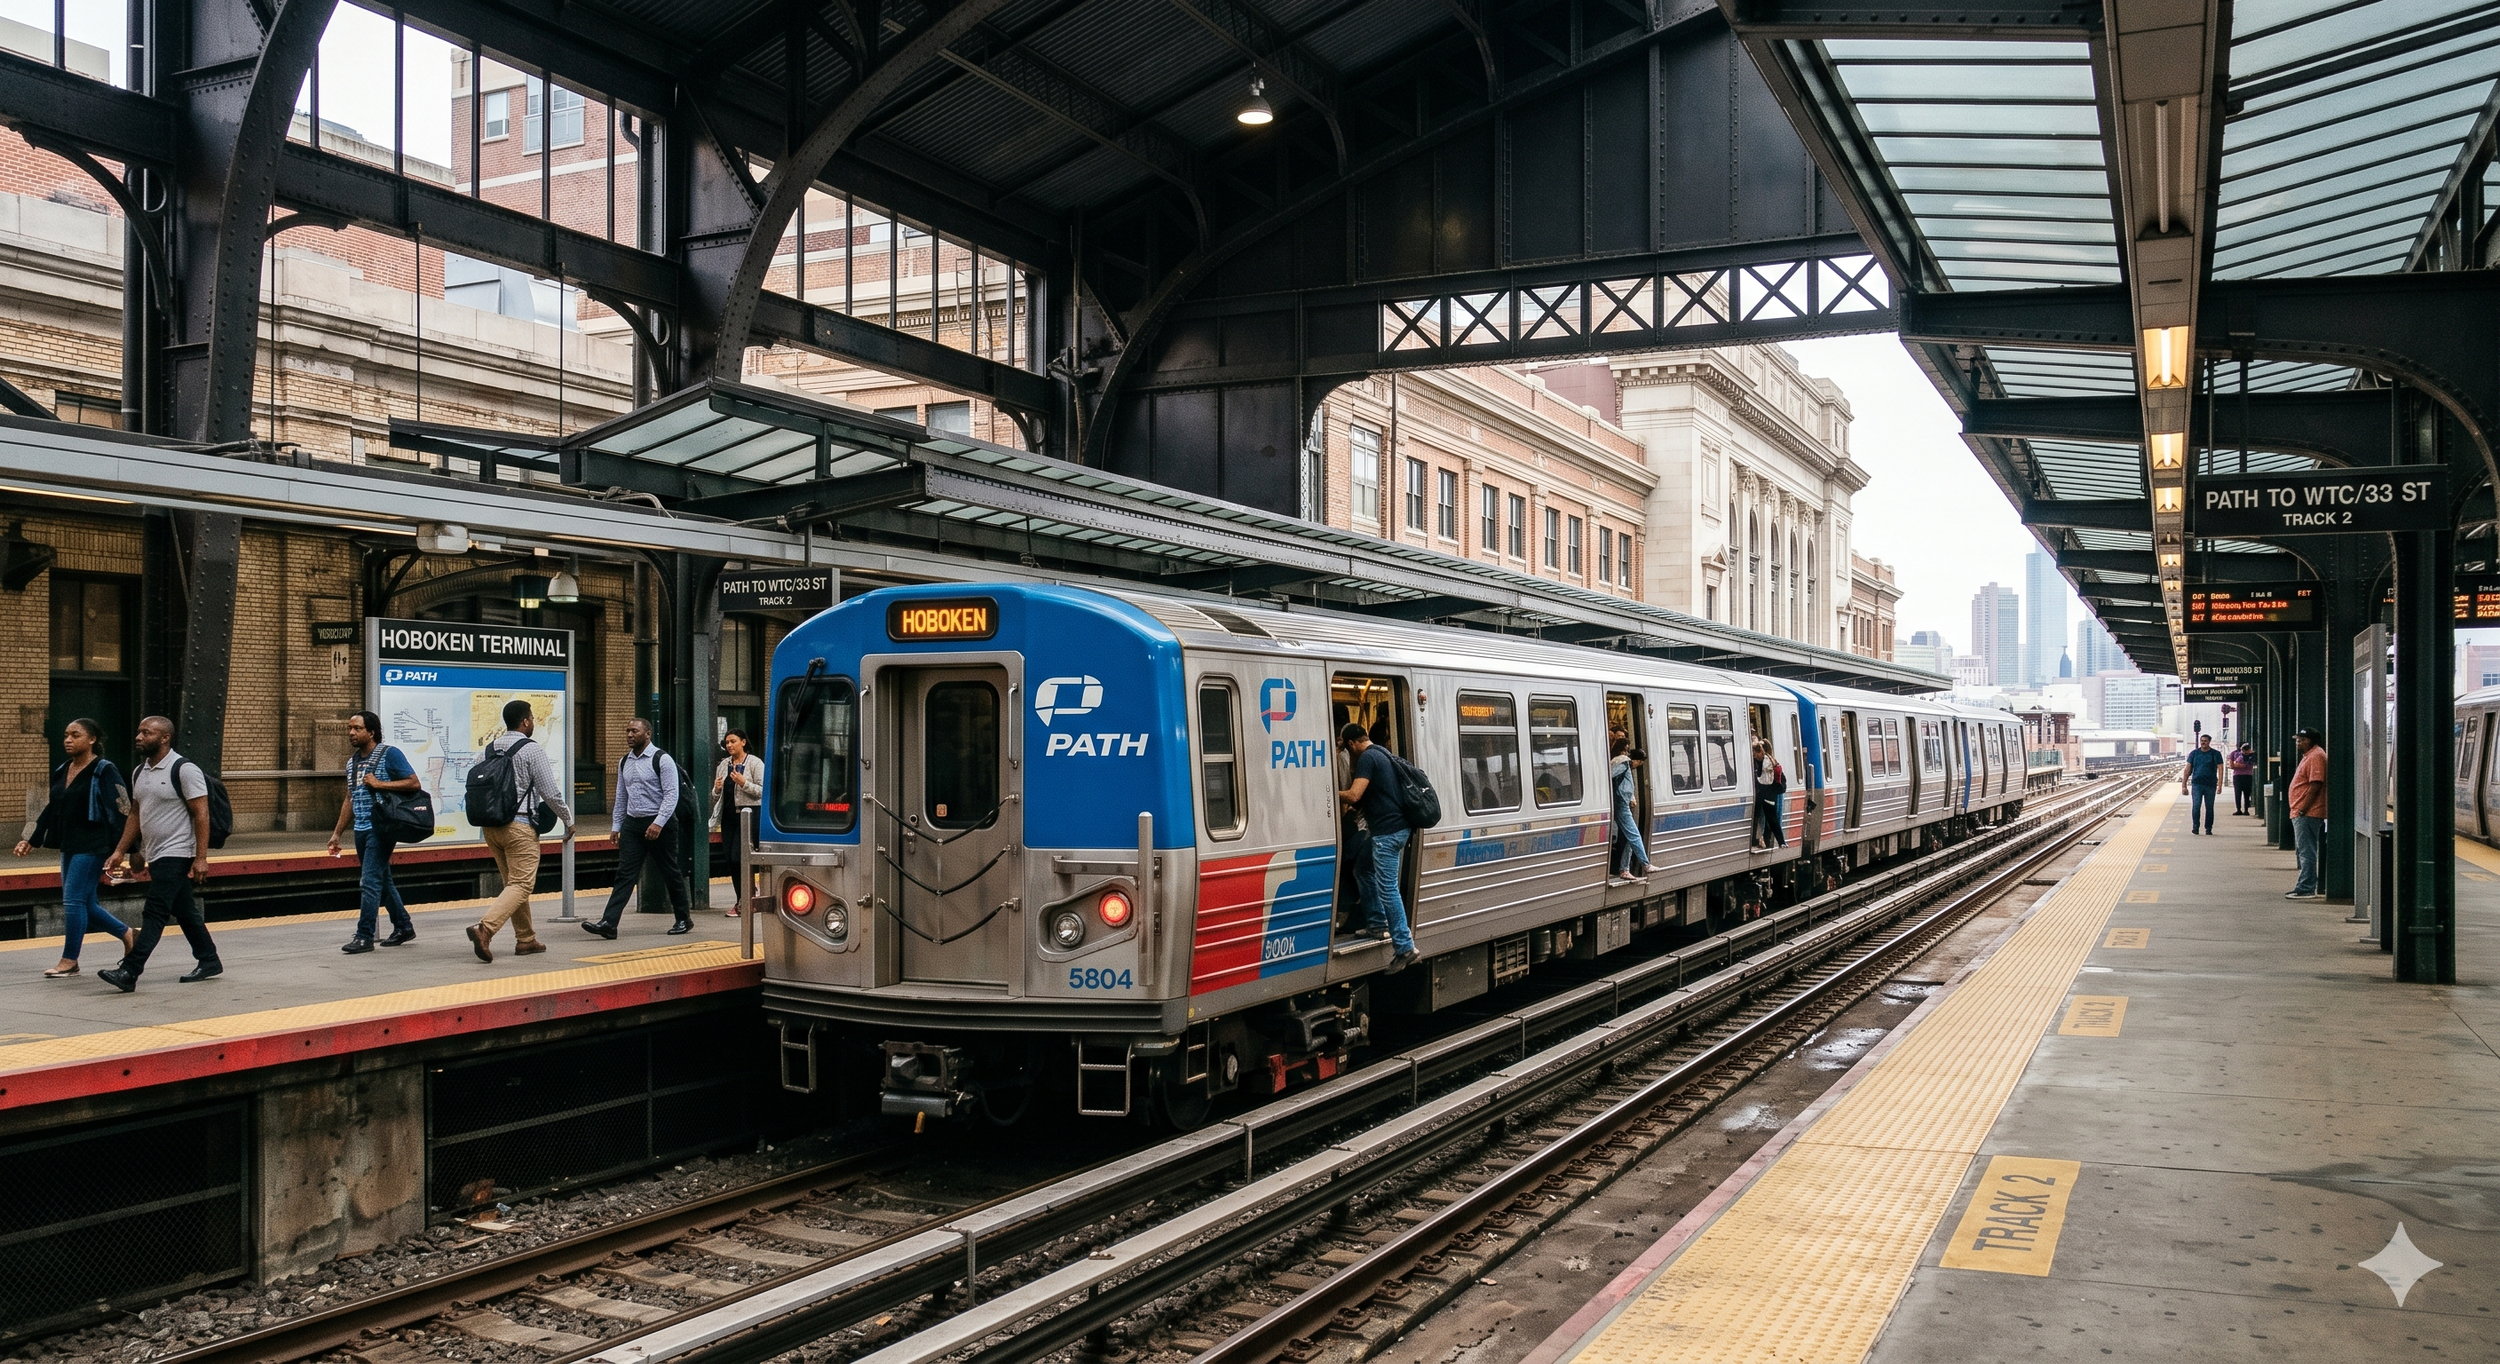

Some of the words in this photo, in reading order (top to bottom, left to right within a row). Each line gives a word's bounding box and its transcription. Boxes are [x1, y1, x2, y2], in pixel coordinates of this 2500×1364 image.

[2206, 489, 2259, 509] PATH
[2267, 487, 2296, 507] TO
[2304, 483, 2393, 506] WTC/33
[2401, 481, 2431, 502] ST
[2283, 512, 2336, 526] TRACK
[2342, 511, 2353, 524] 2
[723, 581, 750, 594] PATH
[752, 580, 766, 593] TO
[768, 577, 810, 592] WTC/33
[812, 577, 827, 590] ST
[759, 596, 785, 606] TRACK
[787, 596, 793, 605] 2
[903, 608, 986, 633] HOBOKEN
[381, 629, 474, 652] HOBOKEN
[479, 634, 566, 657] TERMINAL
[405, 671, 438, 682] PATH
[1045, 733, 1149, 757] PATH
[1271, 740, 1326, 769] PATH
[1068, 968, 1134, 990] 5804
[2001, 1174, 2056, 1186] 2
[1972, 1190, 2051, 1252] TRACK
